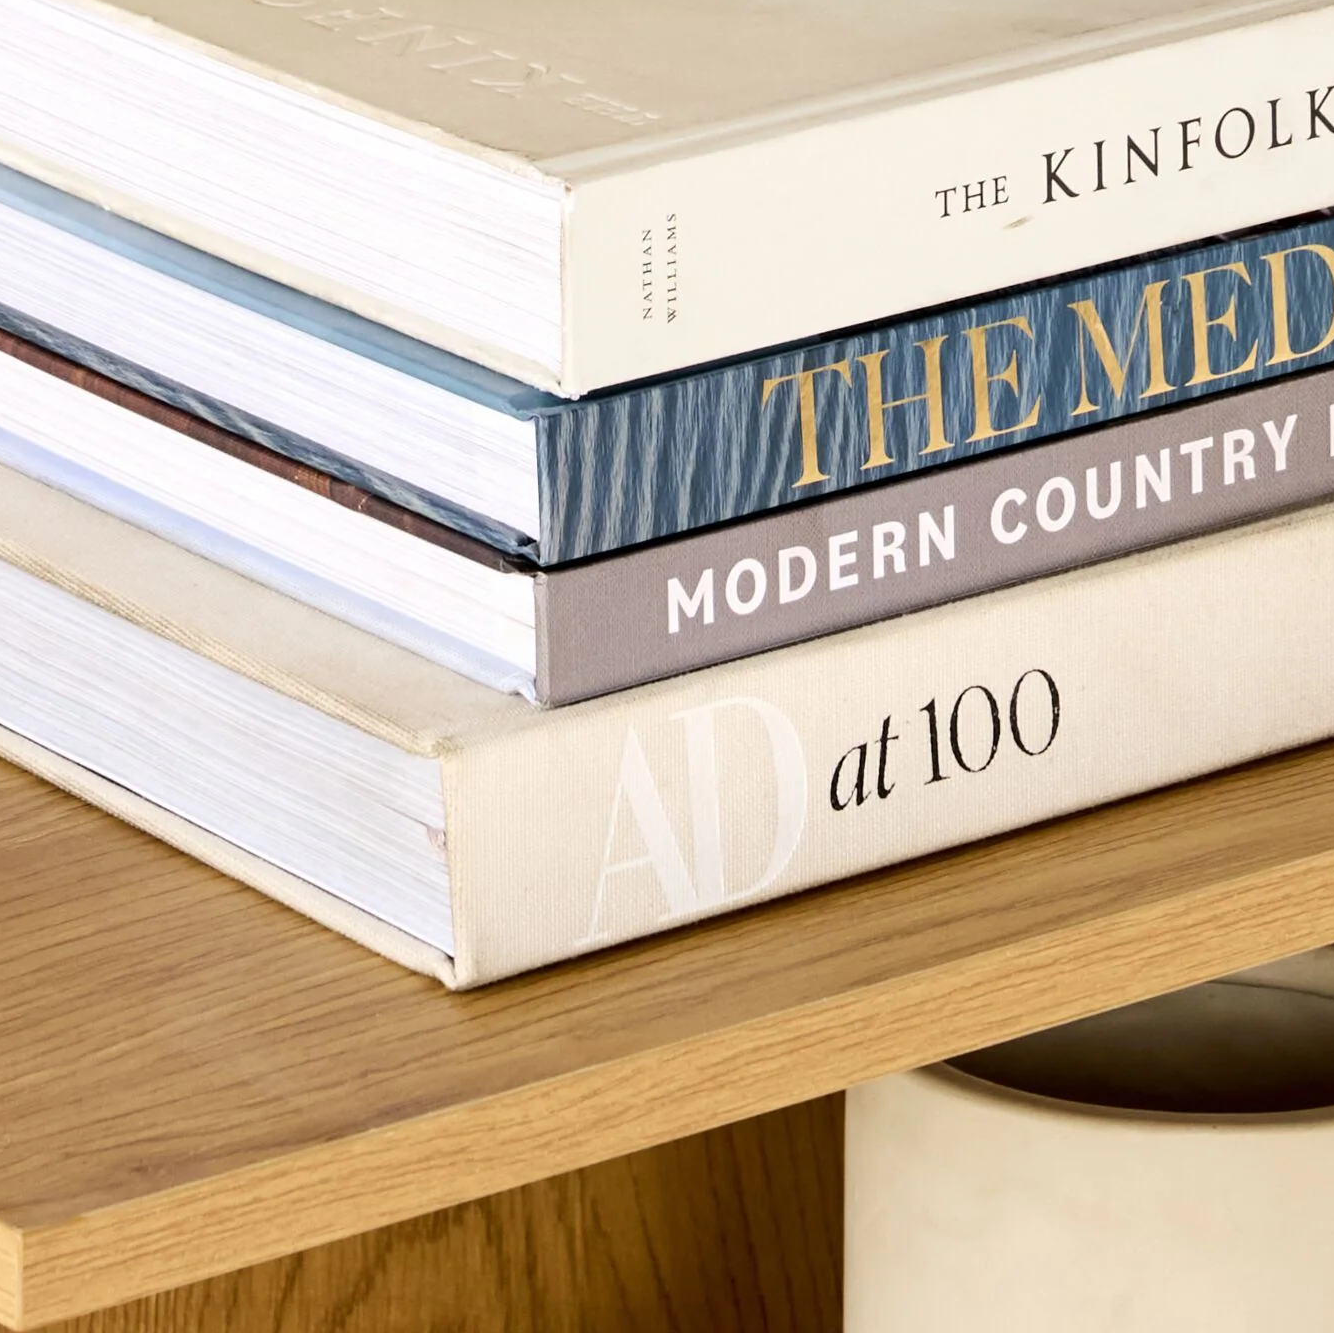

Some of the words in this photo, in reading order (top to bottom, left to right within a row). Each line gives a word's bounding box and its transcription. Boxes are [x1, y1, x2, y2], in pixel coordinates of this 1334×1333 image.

[934, 175, 1010, 219] THE
[642, 229, 653, 321] NATHAN
[667, 213, 677, 324] WILLIAMS
[762, 315, 1042, 489] THE
[667, 505, 956, 634] MODERN
[990, 413, 1299, 545] COUNTRY
[576, 695, 809, 948] AD
[829, 714, 900, 811] at
[920, 669, 1060, 785] 100
